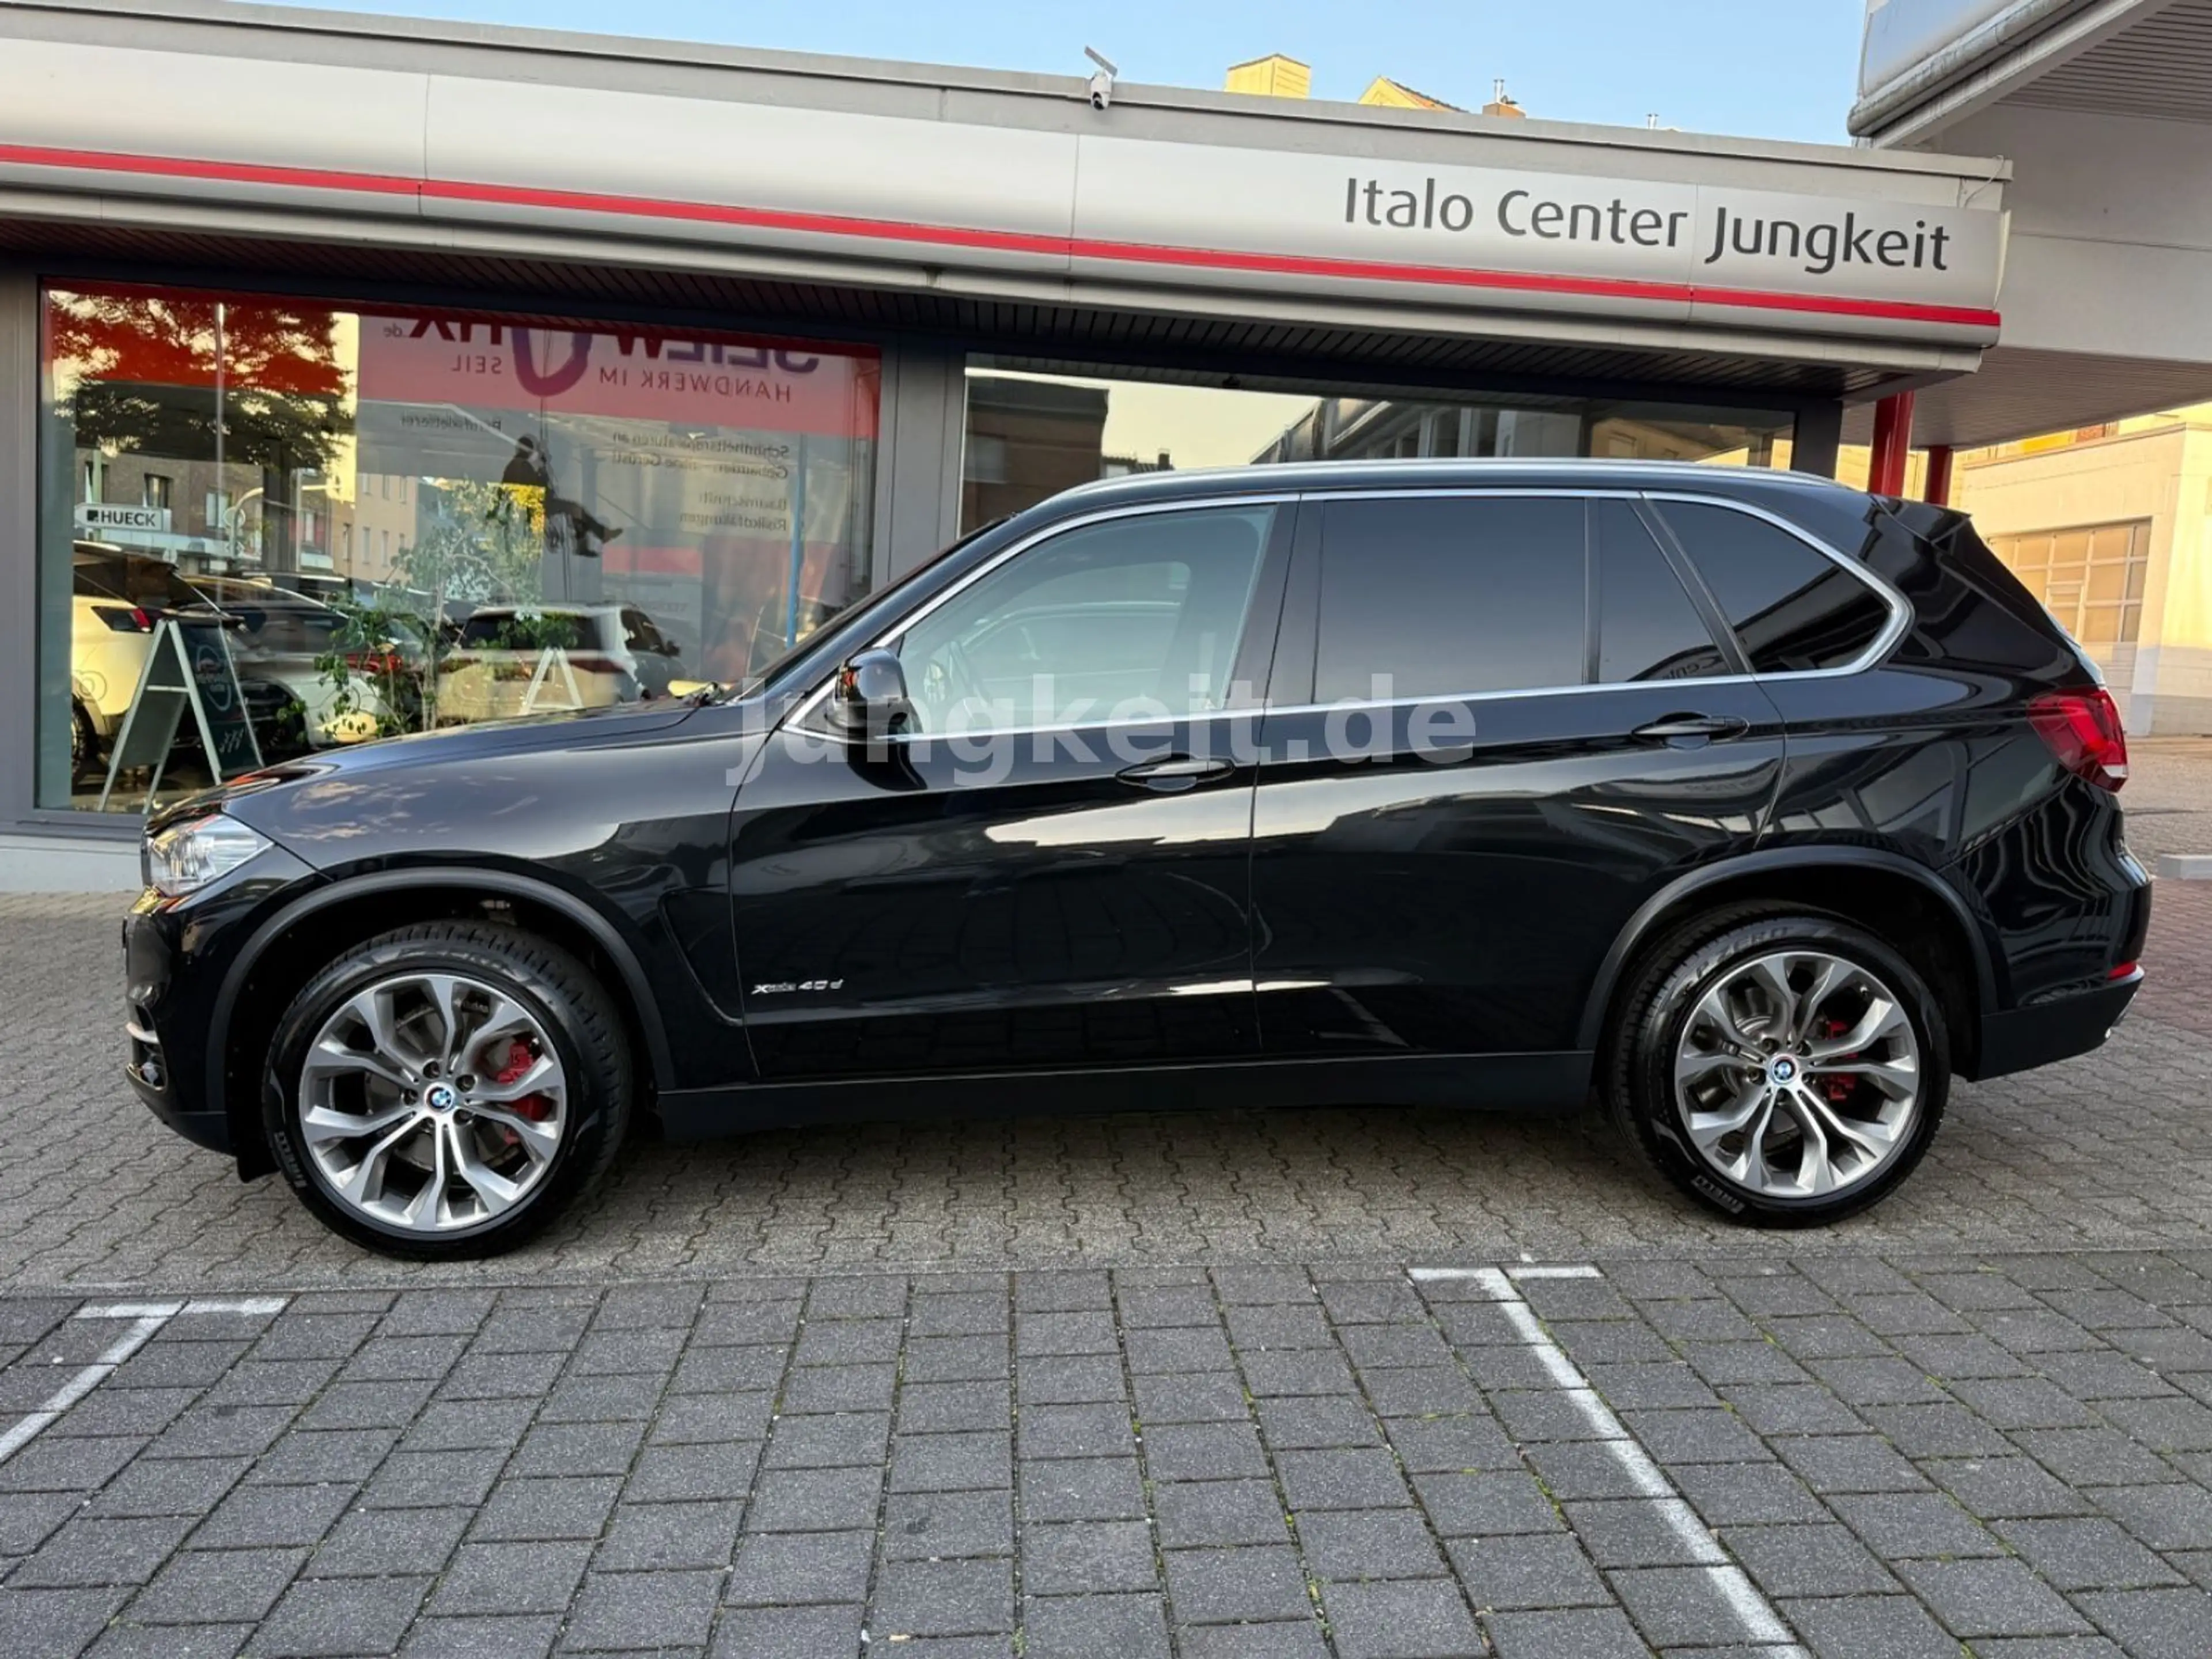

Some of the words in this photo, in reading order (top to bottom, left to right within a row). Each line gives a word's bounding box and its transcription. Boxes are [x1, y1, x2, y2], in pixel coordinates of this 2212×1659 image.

[1346, 177, 1473, 232] Italo
[1498, 190, 1688, 248] Center
[1704, 207, 1950, 275] Jungkeit
[101, 510, 156, 527] HUECK
